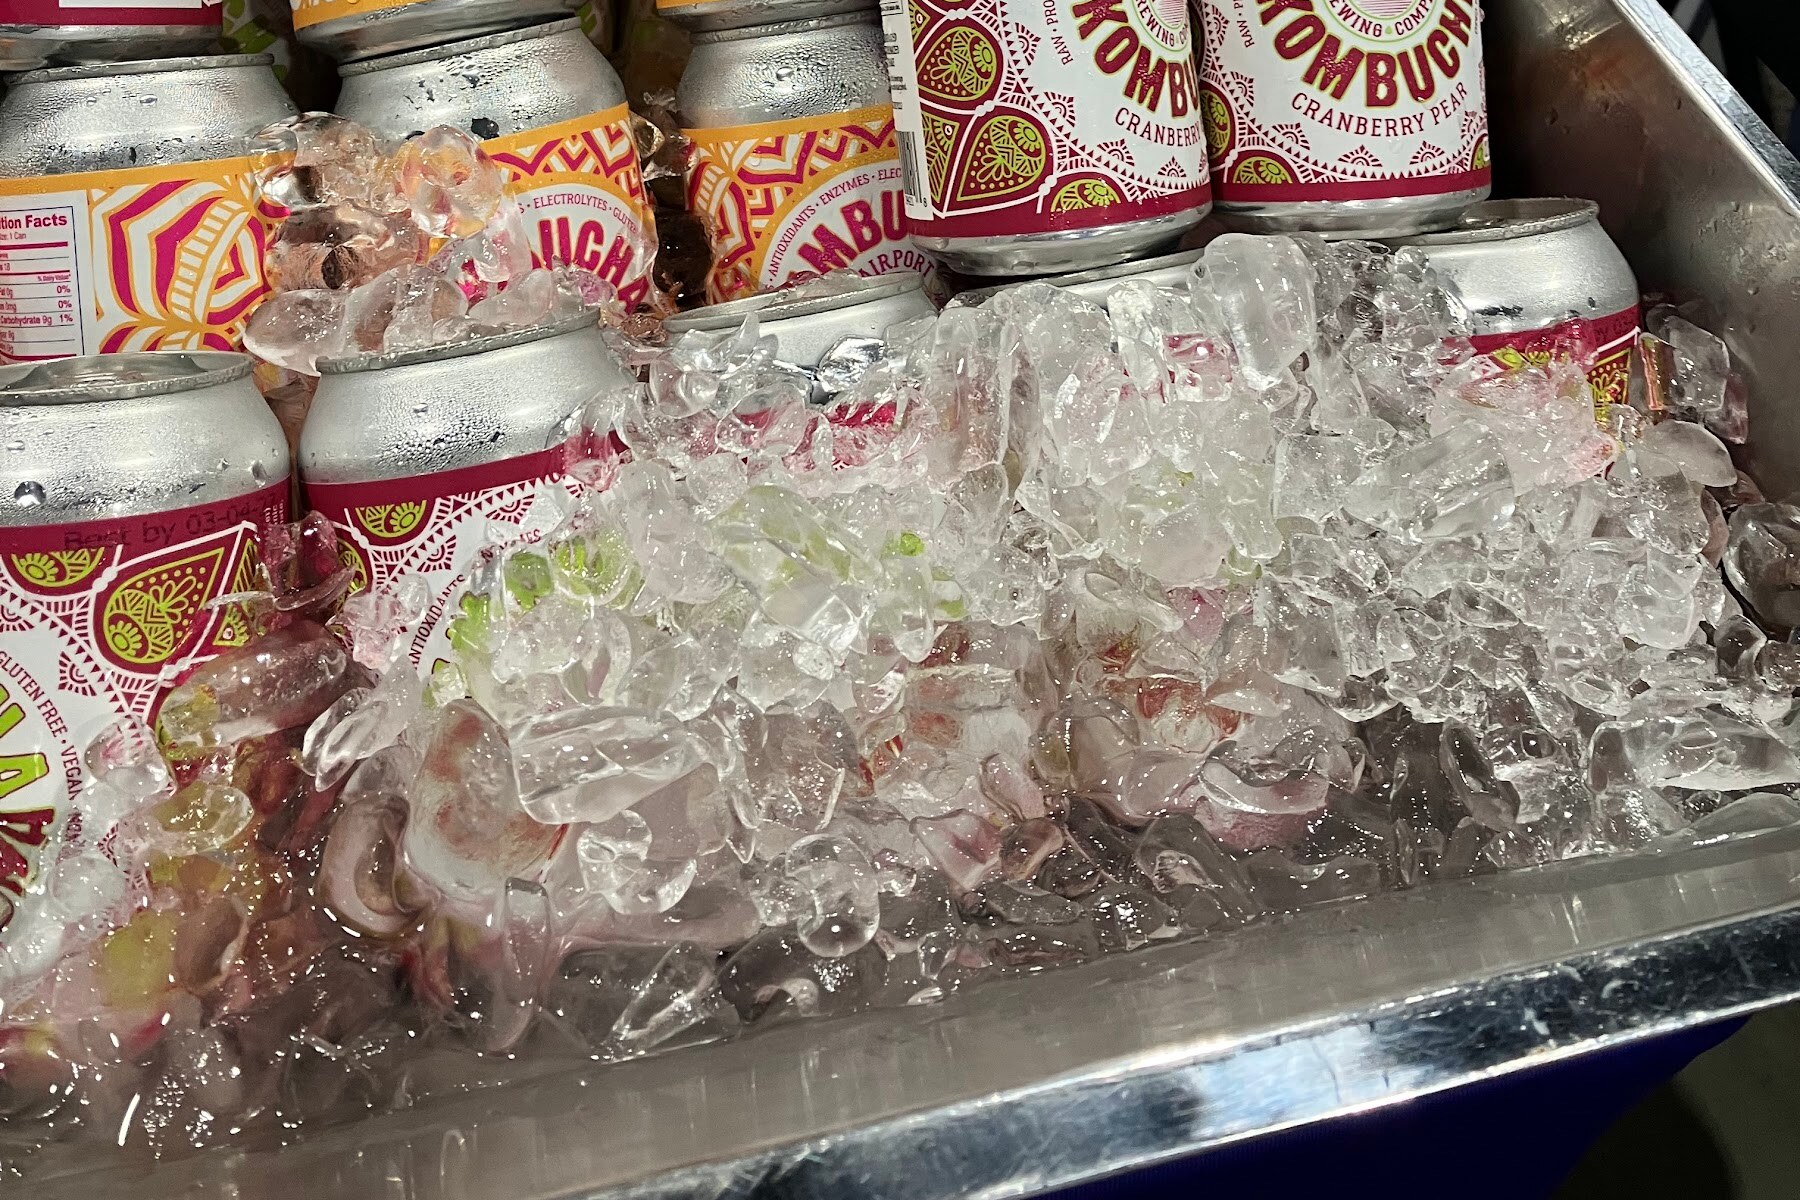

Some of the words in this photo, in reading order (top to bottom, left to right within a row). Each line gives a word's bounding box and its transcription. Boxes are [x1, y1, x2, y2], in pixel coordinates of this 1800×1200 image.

[1237, 20, 1255, 48] RAW
[1050, 35, 1074, 66] RAW
[1292, 92, 1424, 137] CRANBERRY
[1430, 82, 1467, 126] PEAR
[25, 214, 68, 228] Facts
[533, 194, 608, 211] ELECTROLYTES
[613, 207, 637, 234] GLUTE
[768, 205, 816, 277] ANTIOXIDANTS
[819, 173, 870, 206] ENZYMES
[14, 232, 26, 240] Can
[537, 216, 650, 316] UCHA
[858, 250, 935, 278] AIRPORT
[57, 285, 70, 293] 0%
[58, 301, 72, 309] 0%
[60, 314, 73, 322] 1%
[142, 522, 175, 544] by
[37, 700, 68, 738] FREE
